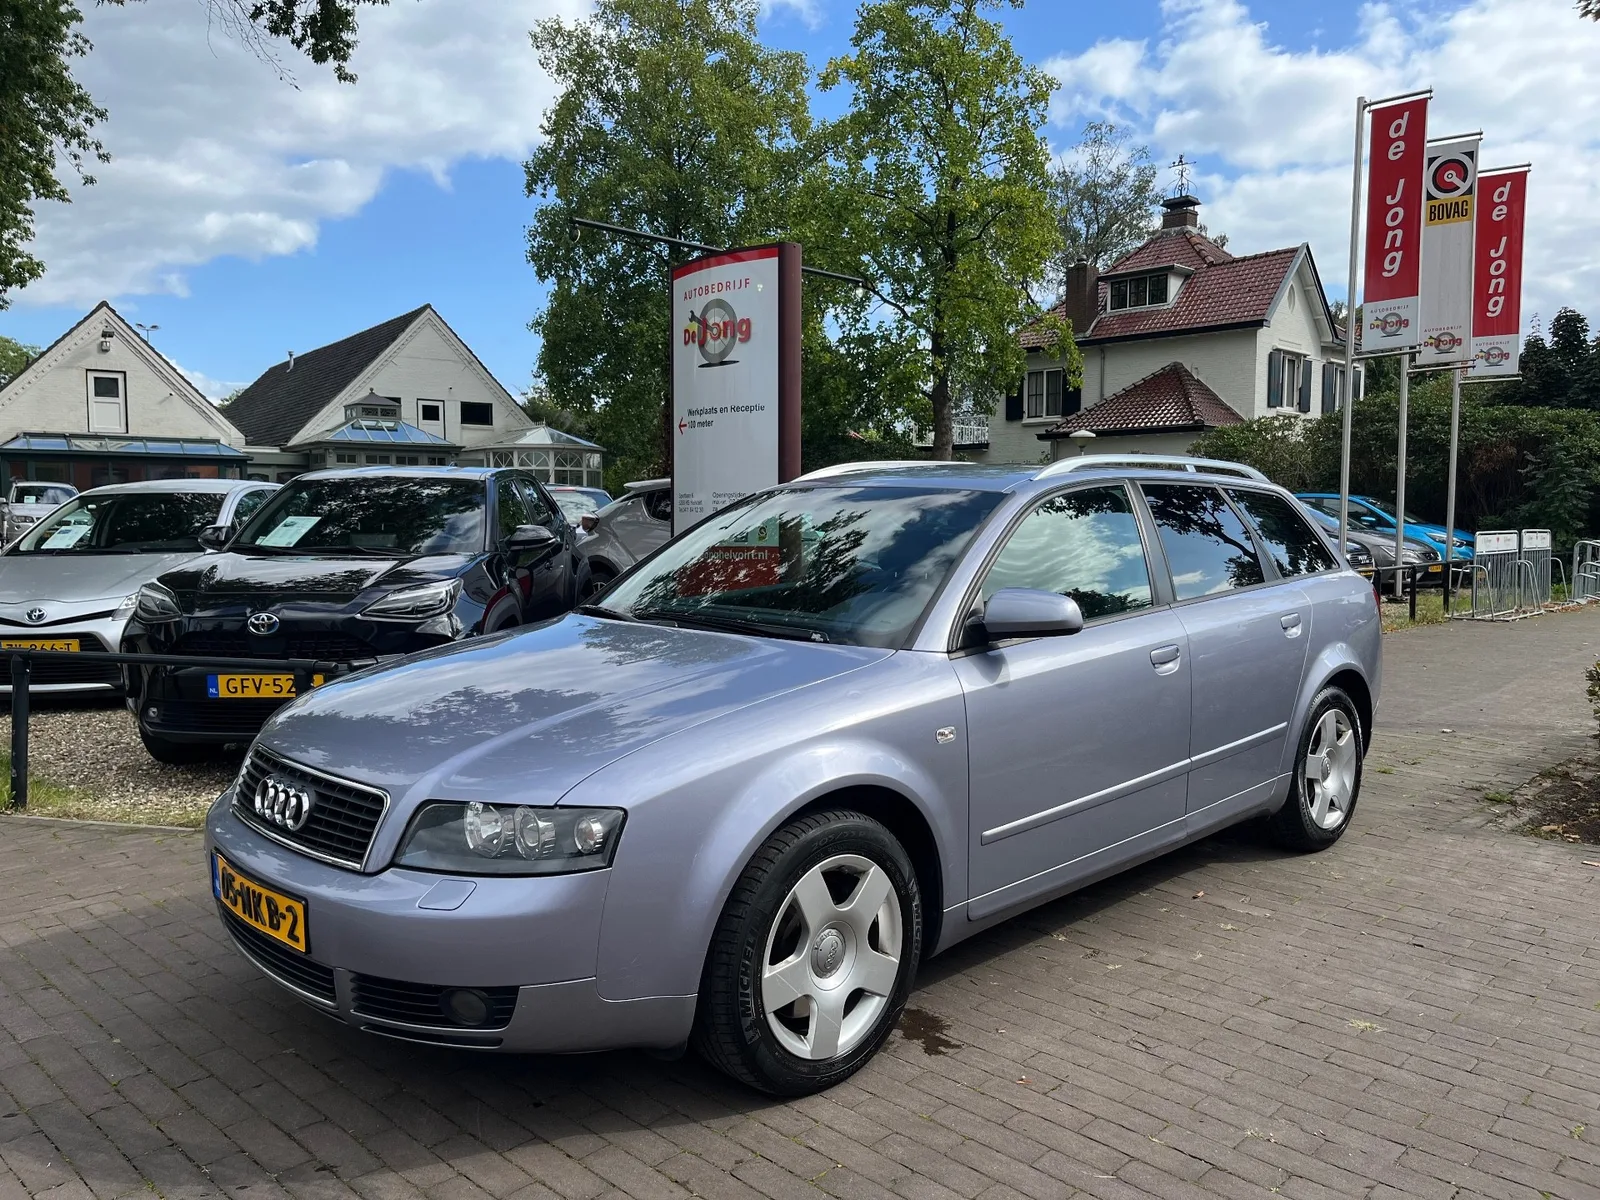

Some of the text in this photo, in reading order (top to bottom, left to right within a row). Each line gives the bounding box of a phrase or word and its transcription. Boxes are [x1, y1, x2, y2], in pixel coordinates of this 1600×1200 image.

[1382, 111, 1409, 278] de Jong
[1429, 199, 1468, 222] BOVAG
[1486, 181, 1511, 318] de Jong
[683, 278, 750, 301] AUTOBEDRIJF
[687, 403, 765, 417] Werkplaats en Receptie
[697, 419, 714, 428] meter
[226, 677, 296, 694] GFV-52
